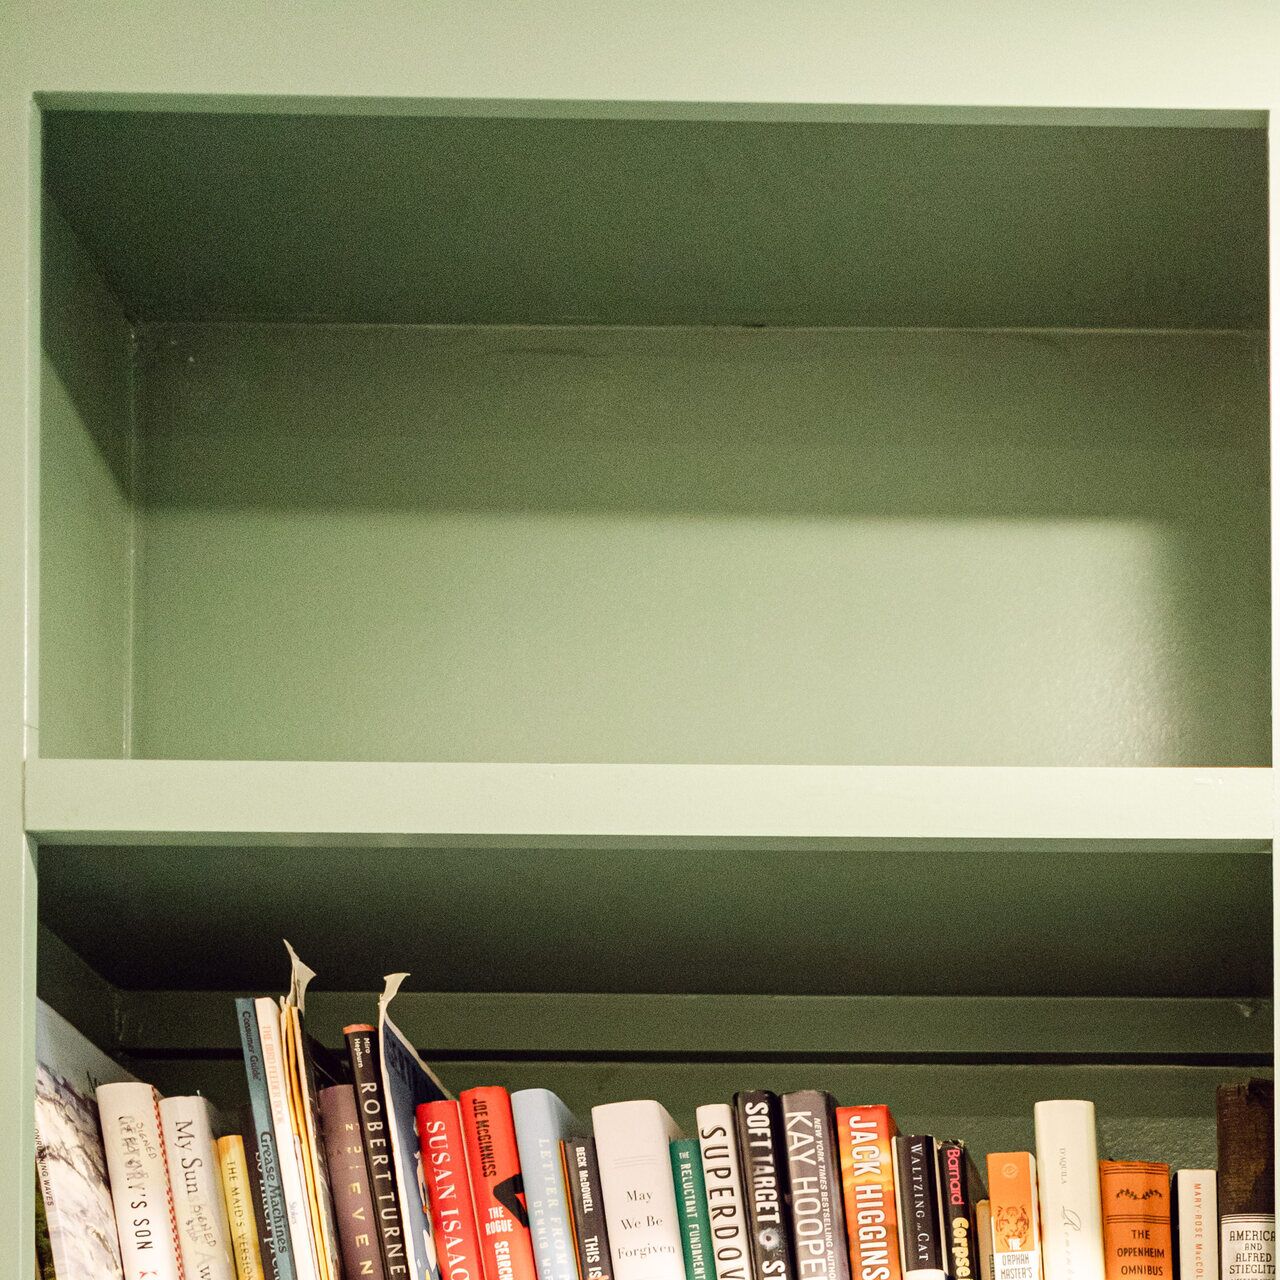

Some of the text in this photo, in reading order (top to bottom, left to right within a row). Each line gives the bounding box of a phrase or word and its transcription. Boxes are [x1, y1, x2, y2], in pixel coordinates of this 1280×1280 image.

[360, 1082, 385, 1179] ROBERT
[813, 1118, 822, 1135] NEW
[785, 1111, 816, 1167] KAY
[849, 1115, 881, 1177] JACK
[816, 1136, 824, 1161] YORK
[819, 1164, 827, 1188] TIMES
[626, 1190, 654, 1203] May
[488, 1207, 504, 1218] THE
[821, 1191, 834, 1244] BESTSELLING
[485, 1219, 513, 1236] ROGUE
[621, 1215, 663, 1230] We Be
[1131, 1229, 1150, 1239] THE
[617, 1243, 677, 1260] Forgiven
[1117, 1247, 1165, 1259] OPPENHEIM
[1121, 1264, 1163, 1276] OMNIBUS
